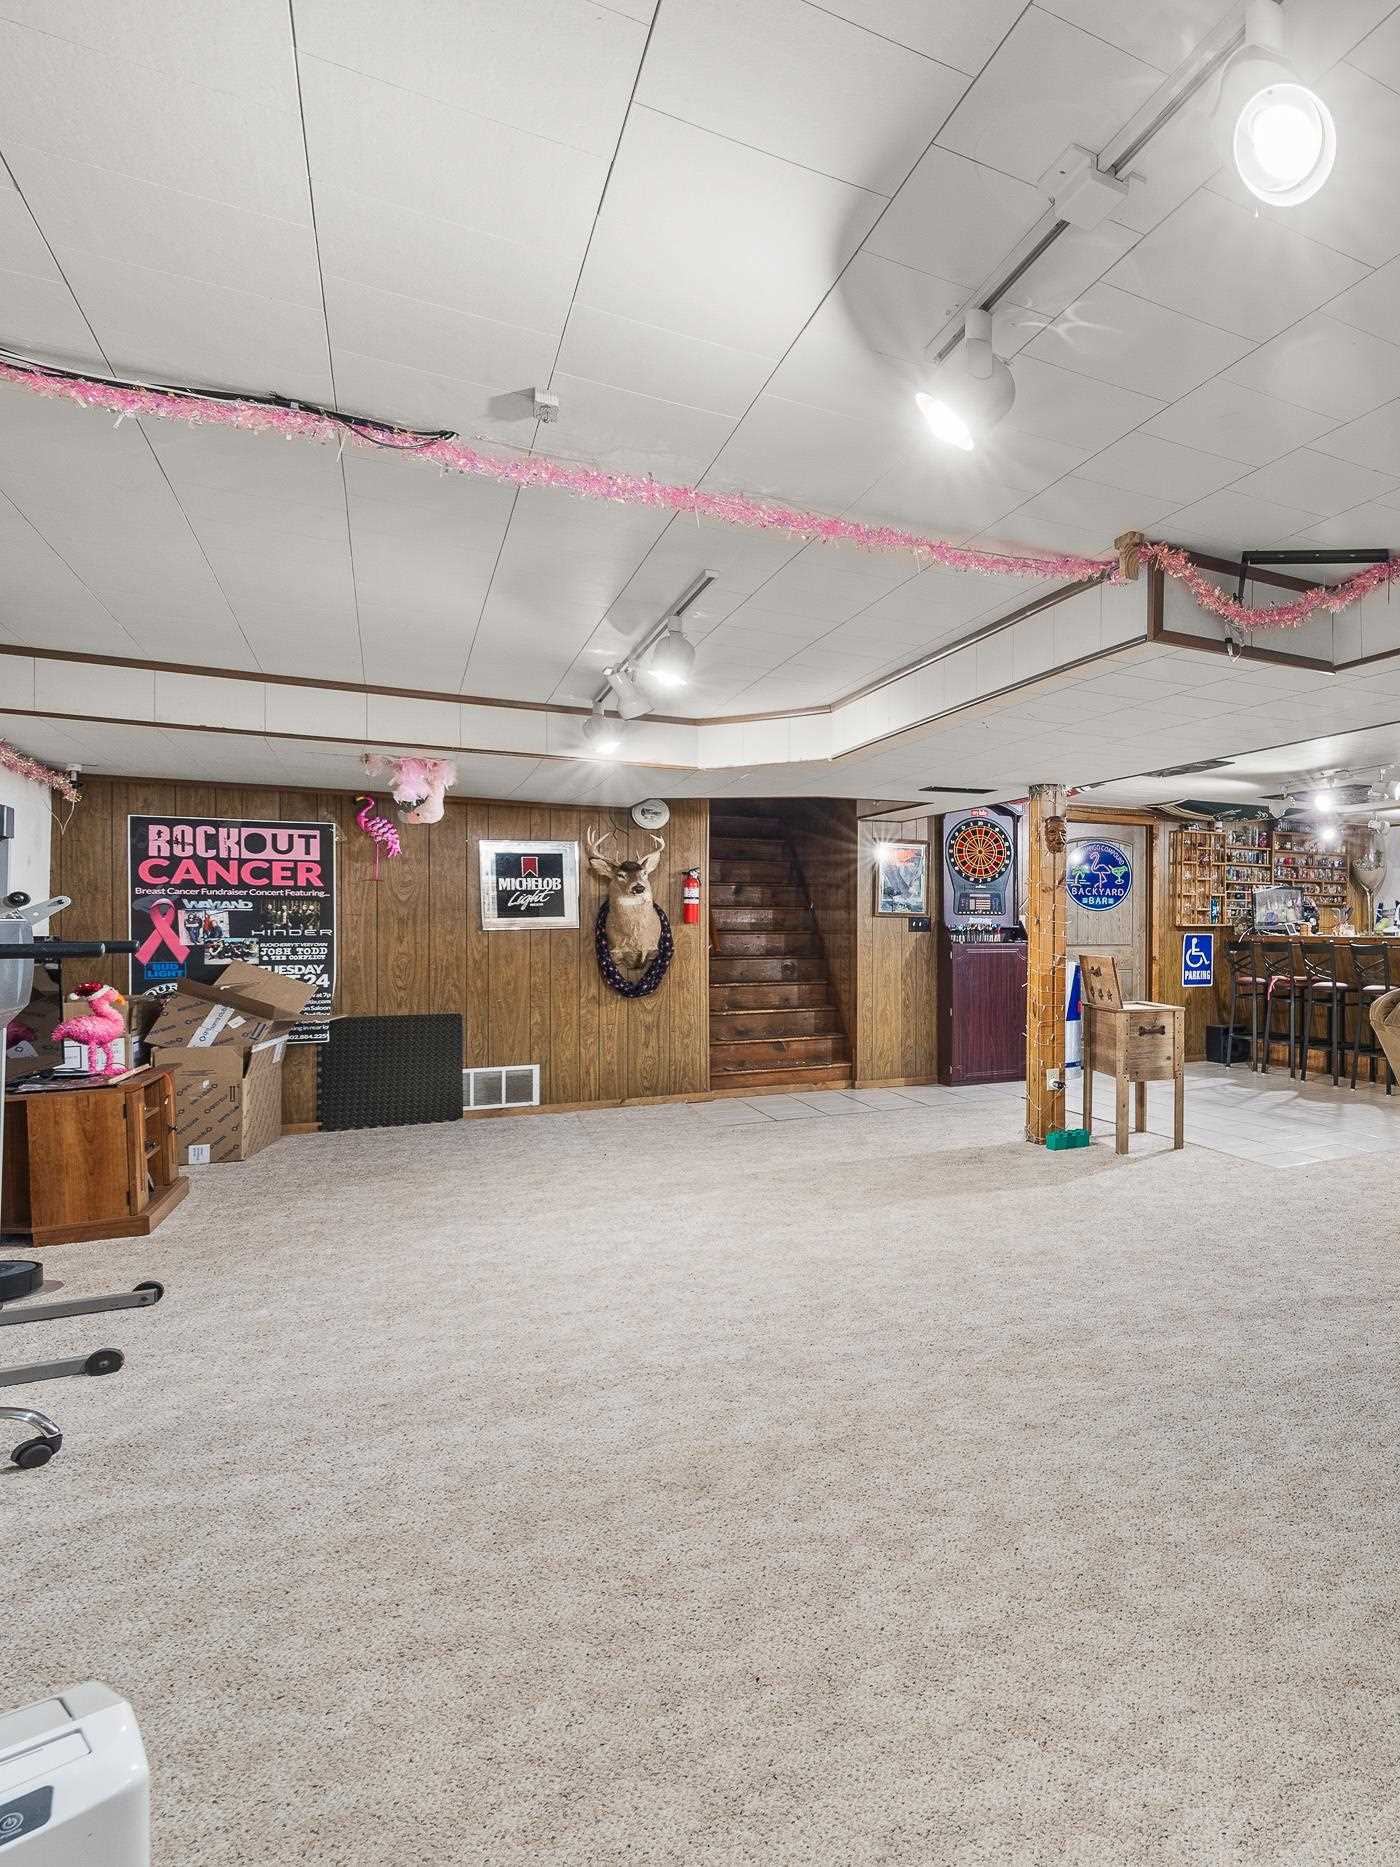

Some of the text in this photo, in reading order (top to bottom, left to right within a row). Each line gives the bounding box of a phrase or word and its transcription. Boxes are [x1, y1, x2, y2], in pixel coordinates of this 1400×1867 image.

[138, 859, 324, 887] CANCER
[499, 878, 562, 890] MICHELOB
[135, 887, 166, 895] Breast
[167, 888, 199, 896] Cancer
[1071, 887, 1125, 896] BACKYARD
[508, 889, 554, 910] Light
[148, 970, 185, 978] LIGHT
[1184, 970, 1210, 980] PARKING
[304, 973, 330, 987] 24
